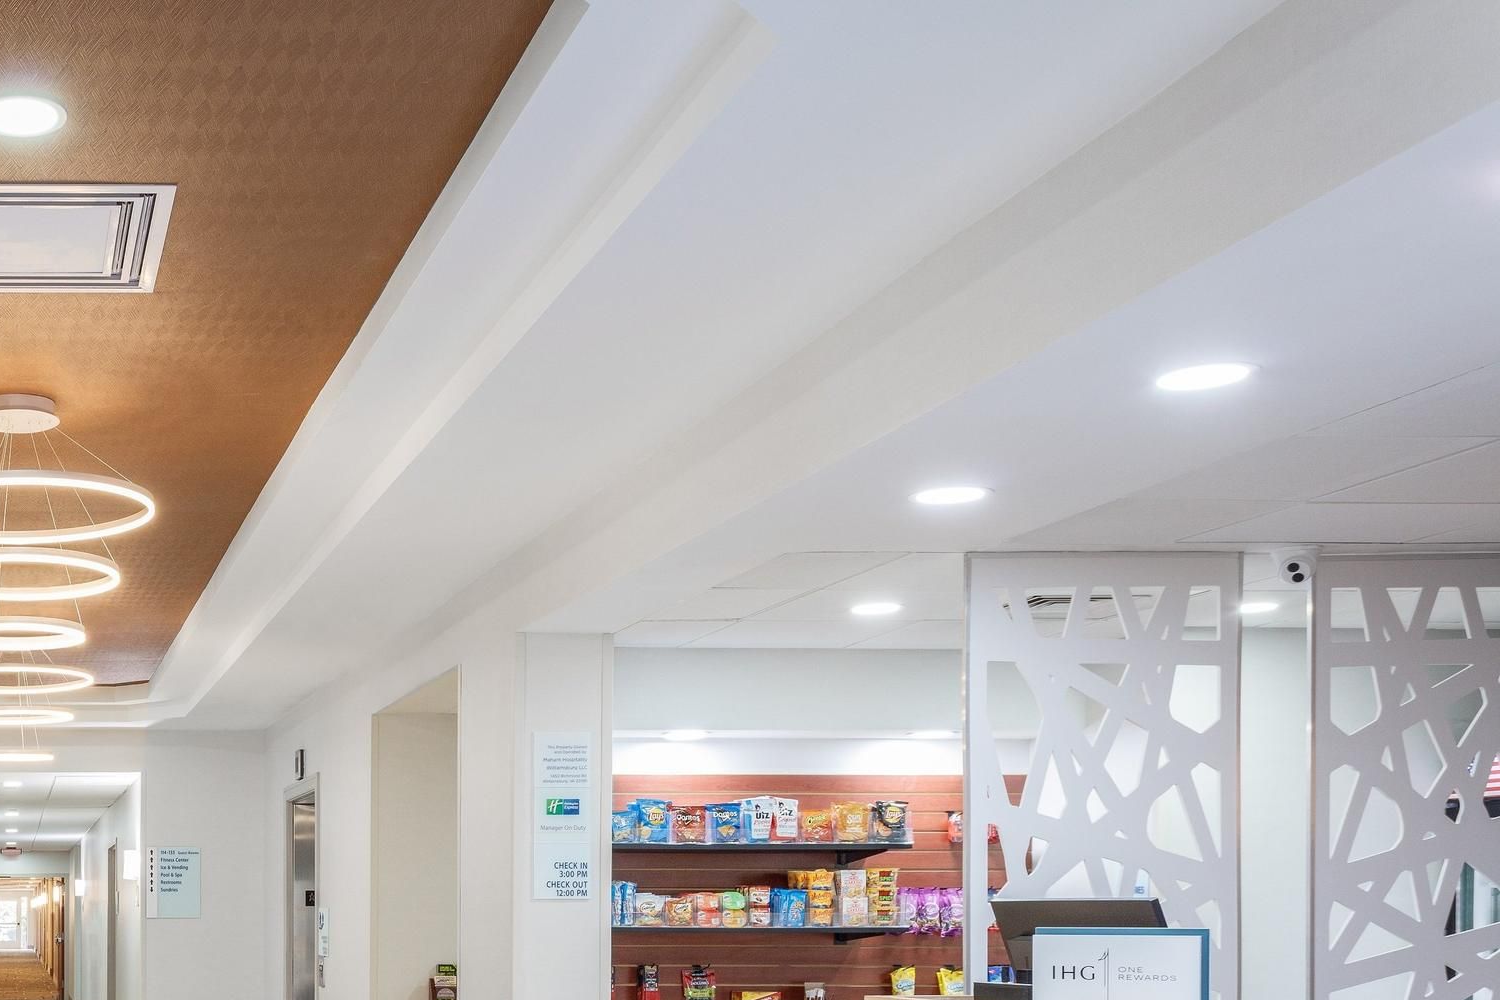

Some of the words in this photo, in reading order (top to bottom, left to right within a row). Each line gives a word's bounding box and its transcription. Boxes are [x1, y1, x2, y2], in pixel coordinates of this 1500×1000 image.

[554, 861, 578, 870] CHECK
[579, 861, 588, 870] IN
[559, 870, 575, 878] 3:00
[576, 870, 588, 878] PM
[546, 881, 570, 889] CHECK
[572, 881, 588, 889] OUT
[556, 889, 575, 897] 12:00
[576, 889, 588, 897] PM
[1051, 964, 1096, 981] IHG
[1117, 974, 1178, 982] REWARDS
